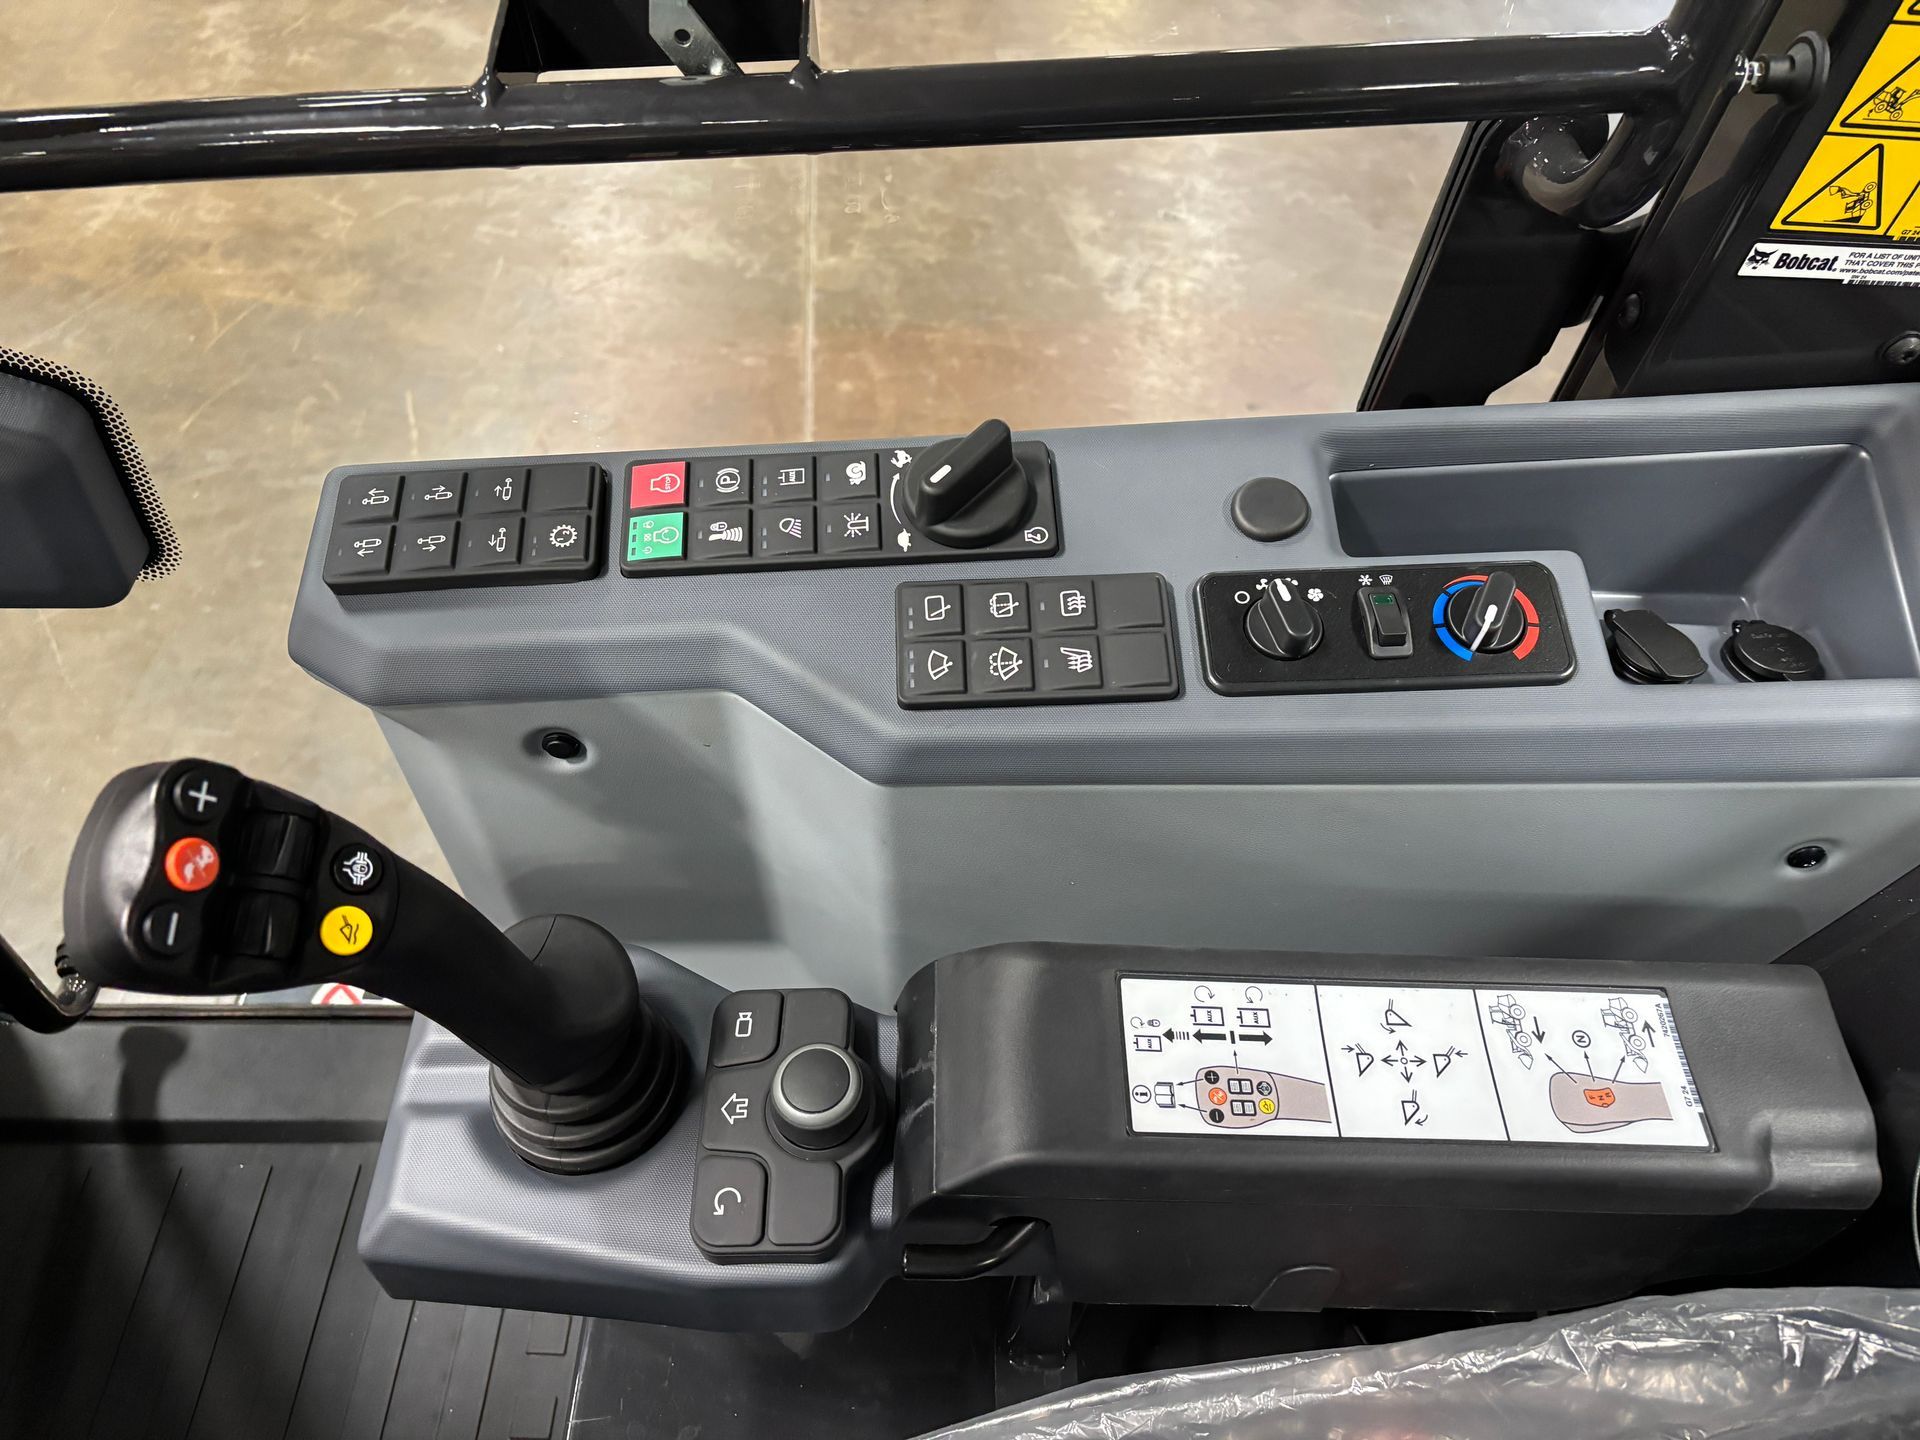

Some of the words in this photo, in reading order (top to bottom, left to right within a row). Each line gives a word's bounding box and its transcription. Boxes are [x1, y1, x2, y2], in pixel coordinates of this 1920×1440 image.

[1866, 260, 1895, 268] COVER
[719, 475, 737, 485] P
[788, 470, 796, 482] AUX
